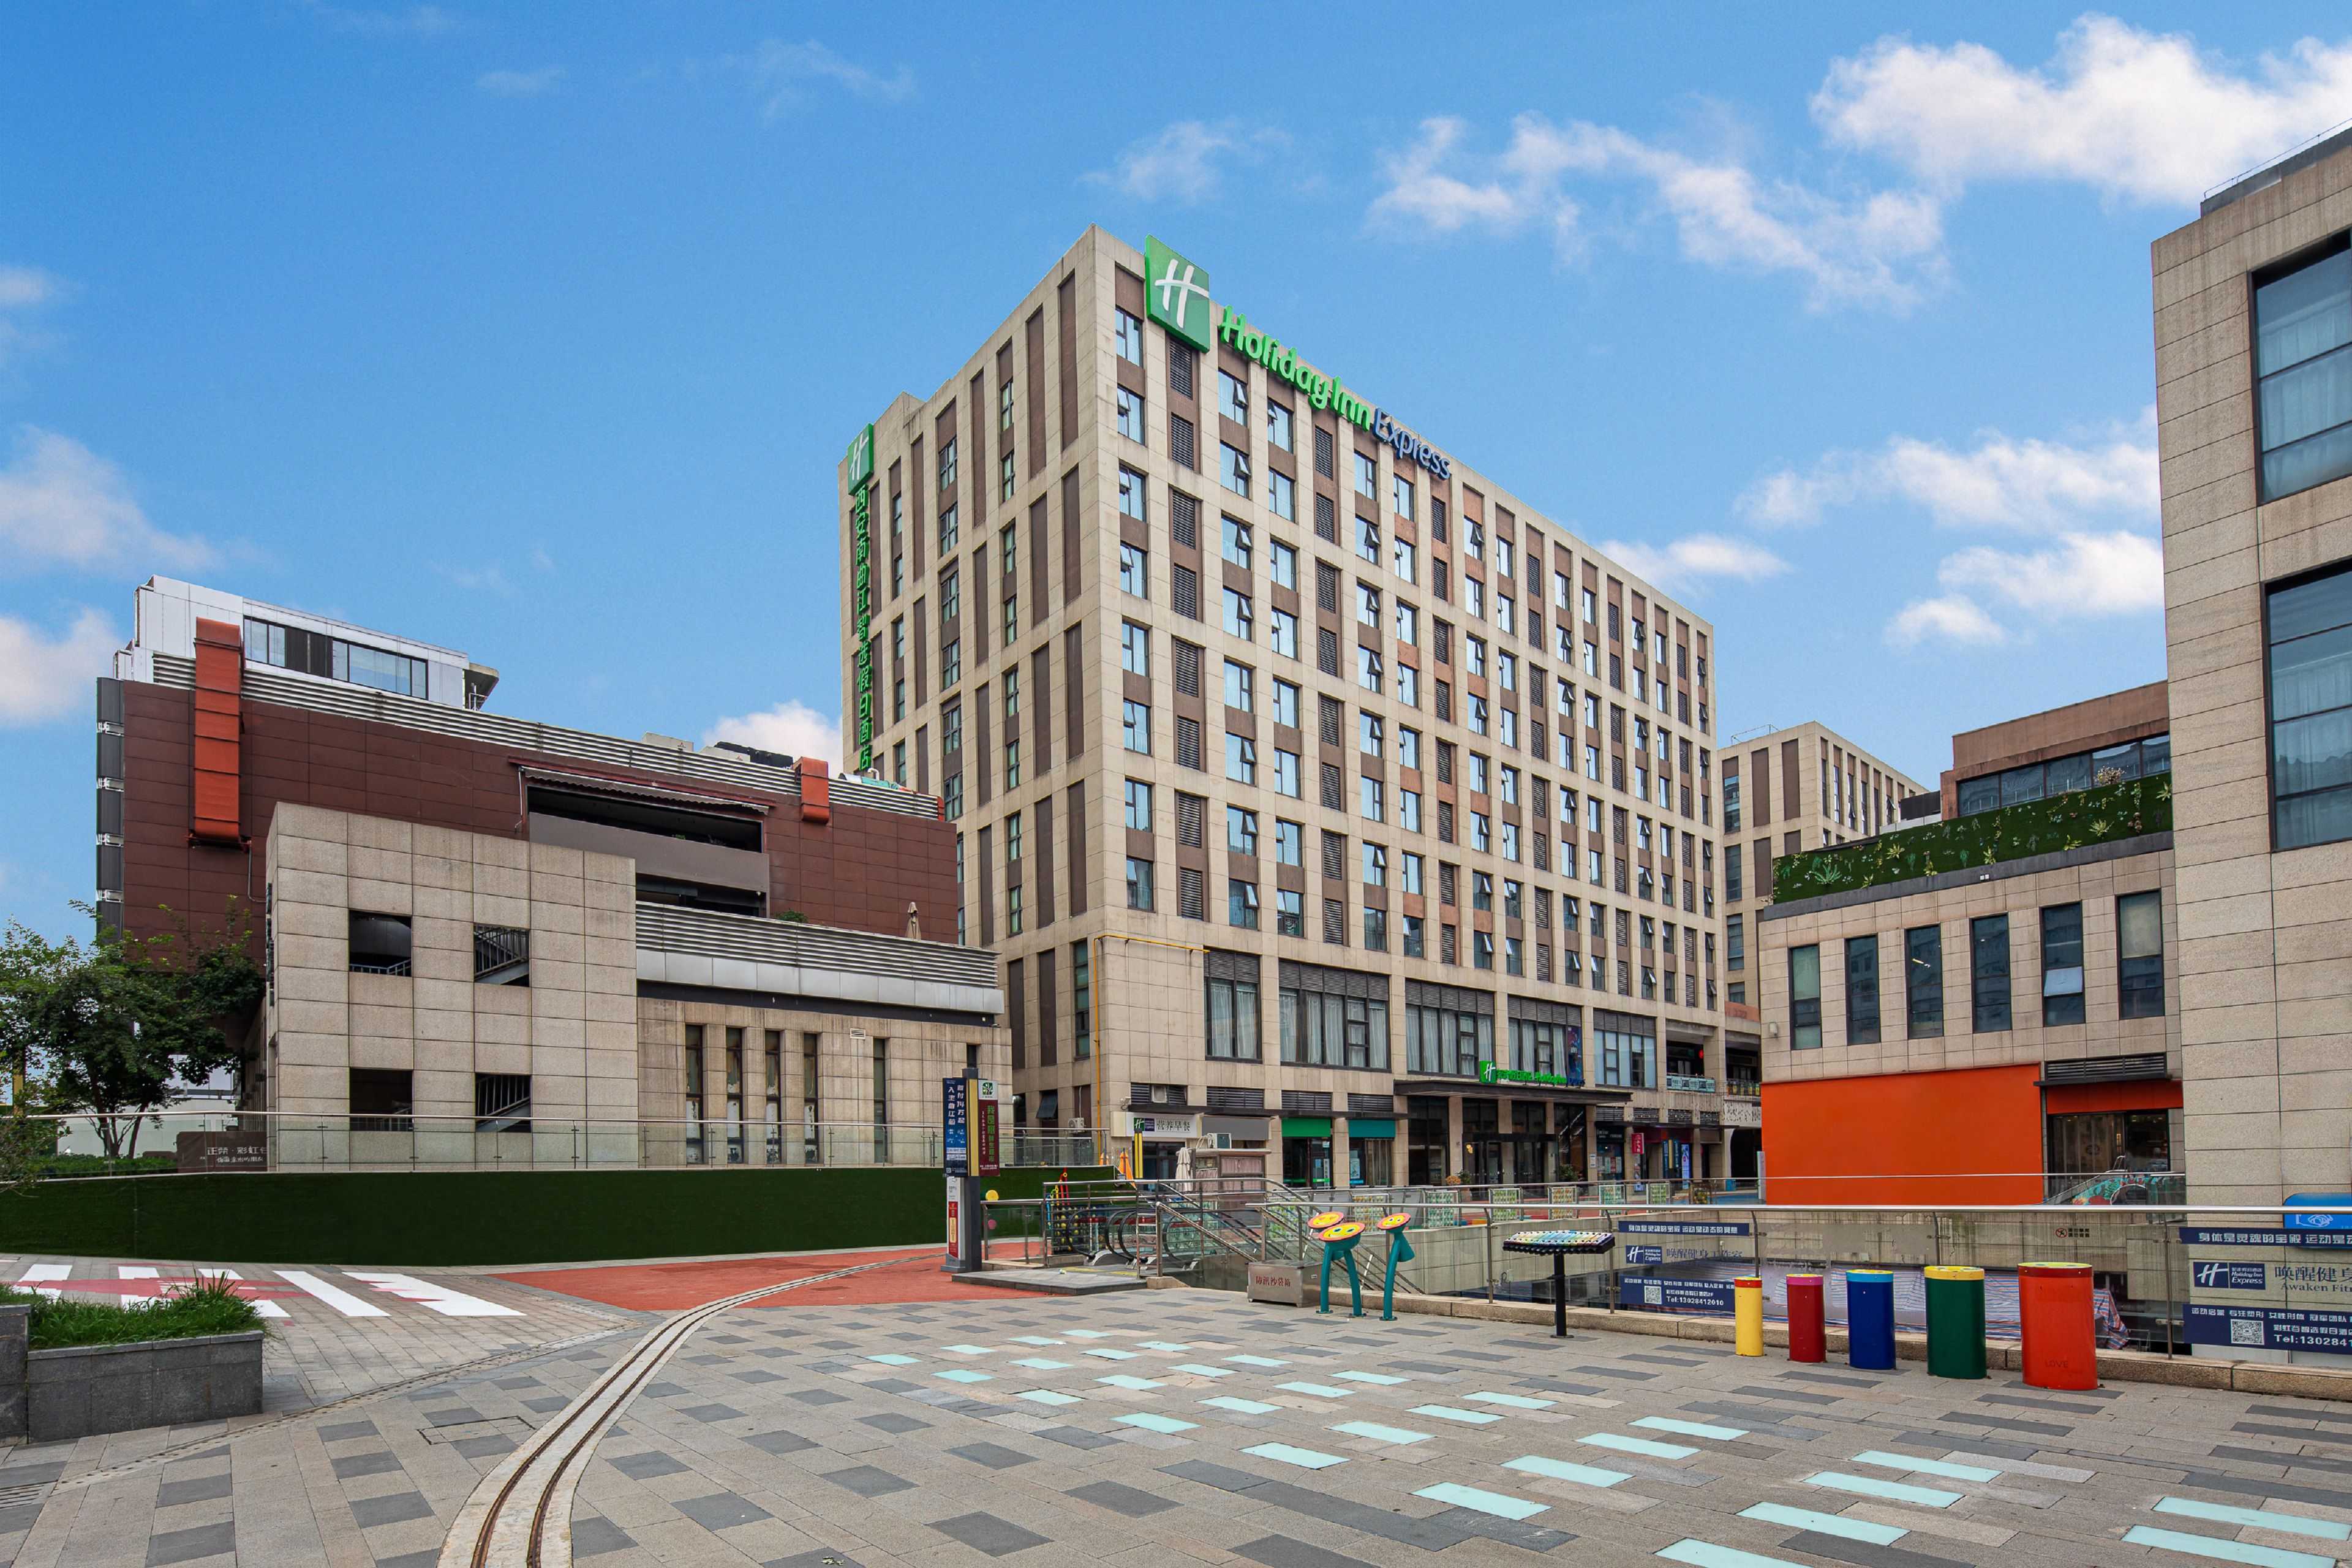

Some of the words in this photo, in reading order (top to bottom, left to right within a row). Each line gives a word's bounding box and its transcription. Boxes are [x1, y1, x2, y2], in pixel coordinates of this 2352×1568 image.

[1218, 305, 1330, 411] Holiday
[1330, 375, 1371, 432] Inn
[1372, 407, 1450, 481] Express
[855, 483, 870, 771] 西安南曲江智选假日酒店
[1156, 1120, 1190, 1131] 营养早餐
[1667, 1248, 1743, 1261] 唤醒健身工作室
[2231, 1276, 2263, 1285] Express
[2281, 1283, 2328, 1292] Awaken
